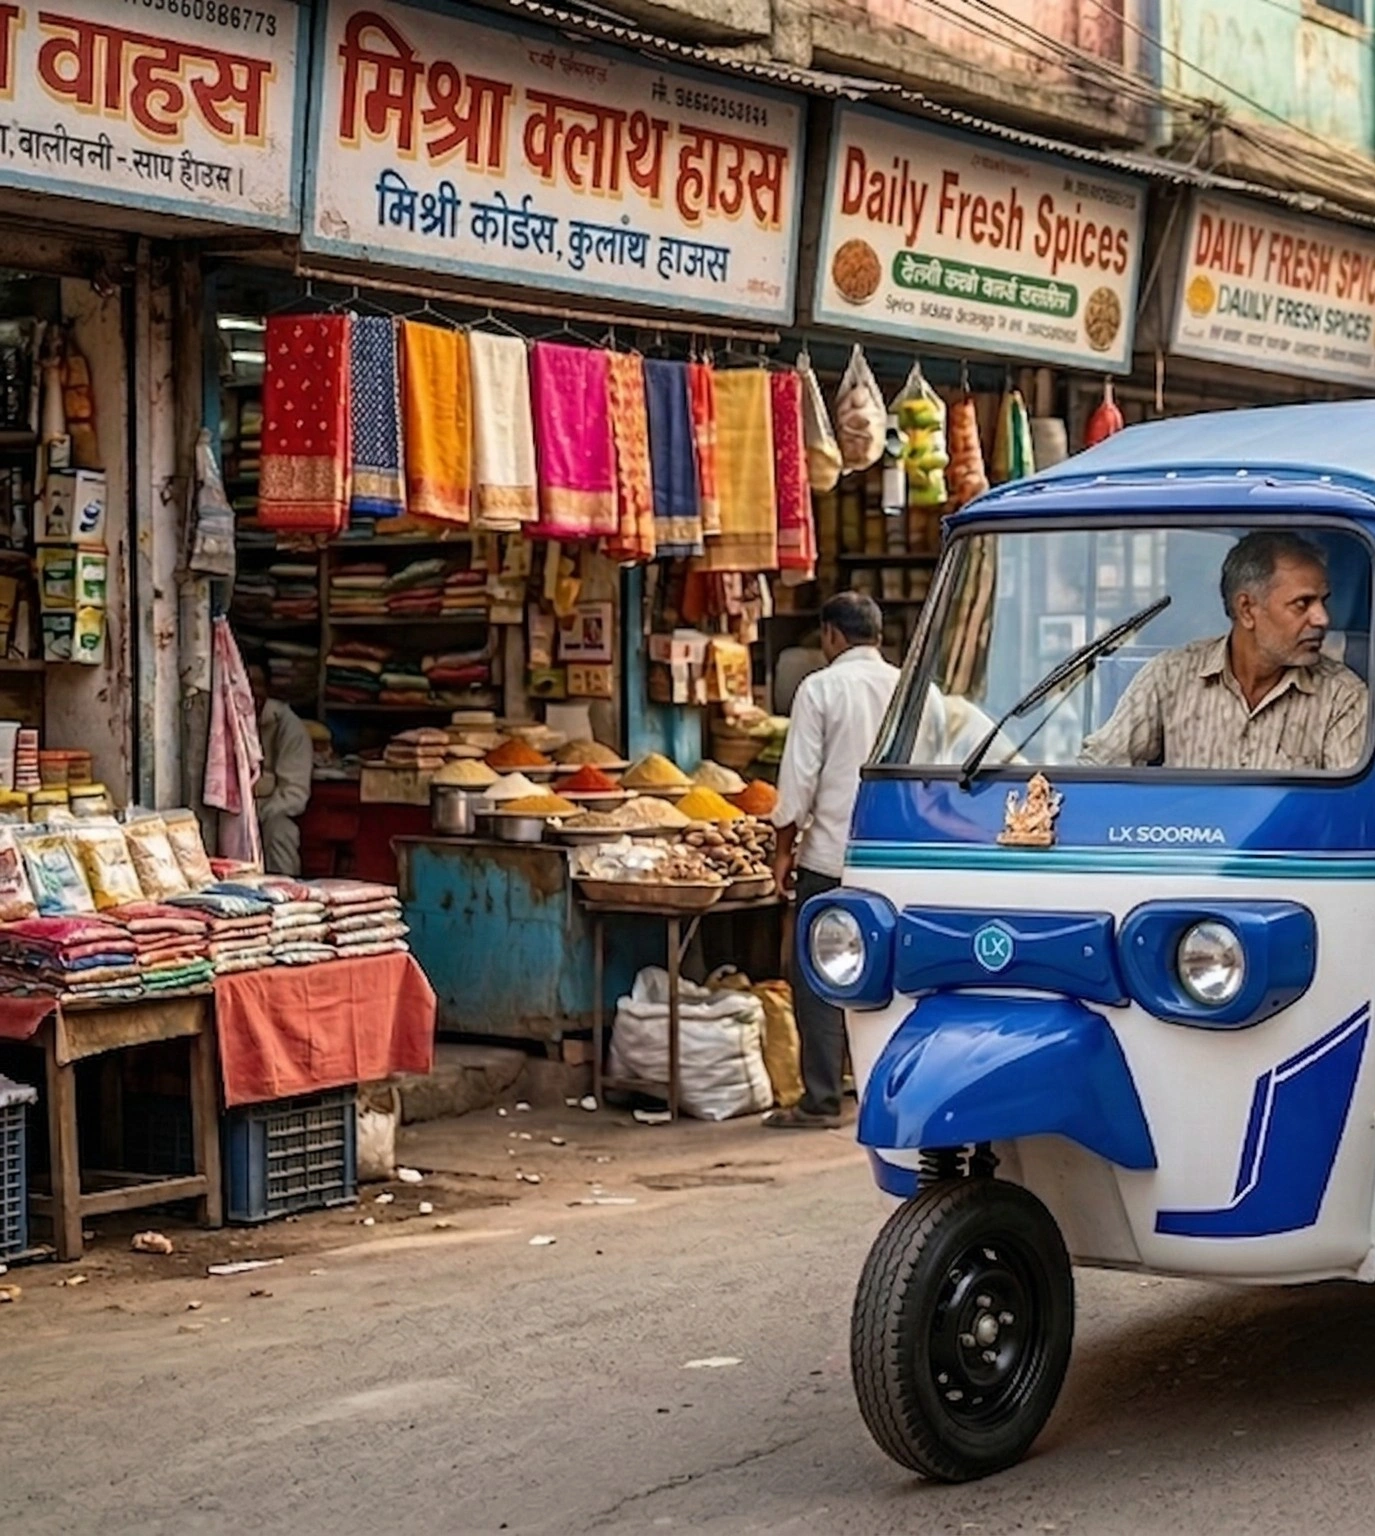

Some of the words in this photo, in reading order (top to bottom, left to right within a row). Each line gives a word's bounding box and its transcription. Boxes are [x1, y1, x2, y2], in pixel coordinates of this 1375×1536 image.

[38, 11, 272, 137] वाहस
[338, 10, 514, 170] मिश्रा
[523, 87, 669, 200] क्लाथ
[676, 123, 789, 224] हाउस
[375, 168, 462, 238] मिश्री
[841, 145, 929, 248] Daily
[935, 169, 1024, 252] Fresh
[1033, 192, 1130, 276] Spices
[1194, 213, 1264, 280] DAILY
[1264, 228, 1334, 296] FRESH
[1275, 296, 1323, 332] FRESH
[1324, 307, 1372, 343] SPICES
[1108, 826, 1134, 842] LX
[1136, 826, 1226, 844] SOORMA
[982, 937, 1006, 957] LX
